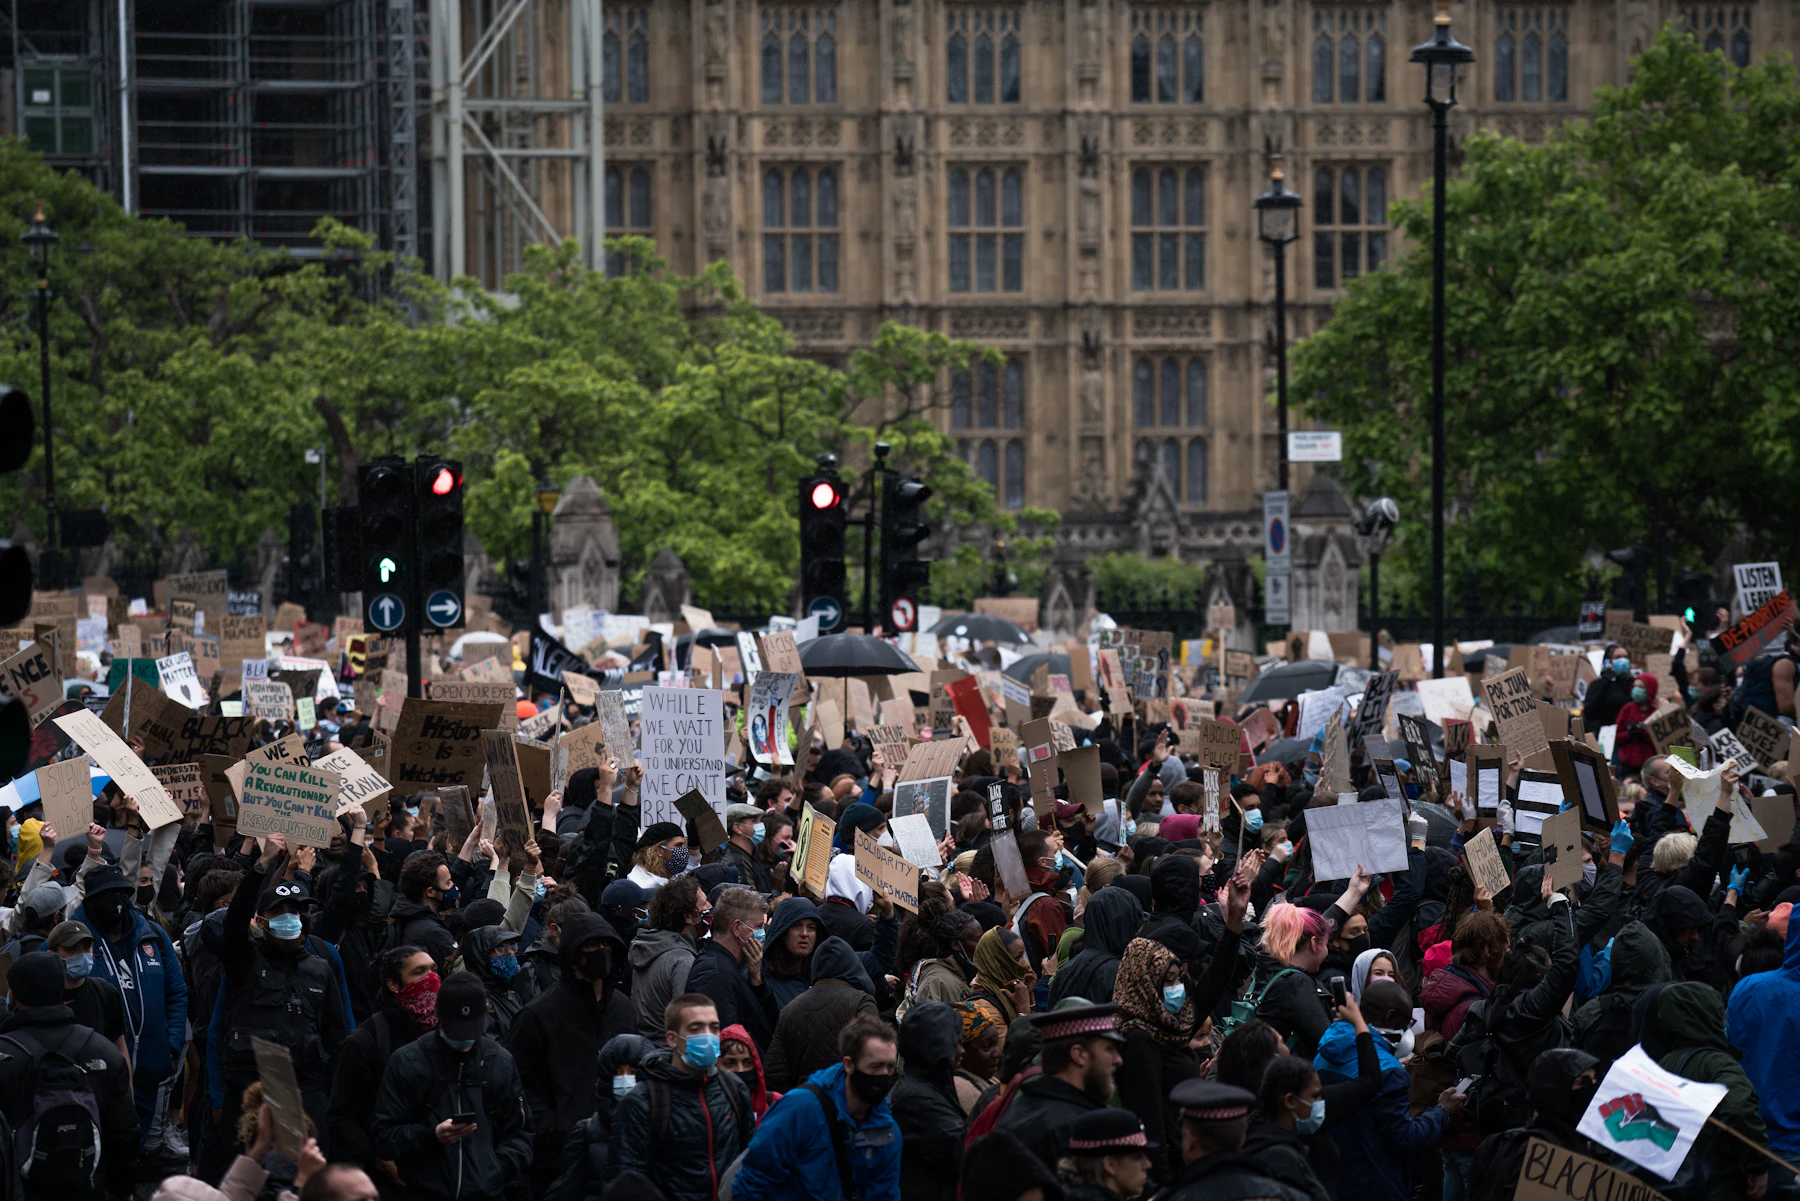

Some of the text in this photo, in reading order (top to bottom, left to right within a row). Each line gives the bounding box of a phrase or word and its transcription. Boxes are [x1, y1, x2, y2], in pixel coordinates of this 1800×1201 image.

[1740, 567, 1777, 588] LISTEN
[224, 627, 261, 640] NAMES
[158, 659, 175, 671] BLACK
[162, 667, 196, 686] MATTER
[433, 685, 516, 699] OPEN YOUR EYES
[1487, 683, 1508, 704] POR
[649, 692, 706, 715] WHILE
[1493, 703, 1513, 724] POR
[181, 717, 252, 740] BLACK
[645, 719, 713, 736] WE WAIT
[1203, 724, 1242, 747] ABOLISH
[264, 742, 290, 761] WE
[654, 739, 703, 754] FOR YOU
[645, 757, 724, 771] TO UNDERSTAND
[47, 759, 91, 798] SILENCE
[645, 774, 672, 796] WE
[1204, 770, 1219, 792] BLACK
[643, 799, 723, 827] BREE
[1205, 791, 1219, 814] LIVES
[242, 811, 329, 841] REVOLUTION
[856, 834, 913, 878] SOLIDARITY
[1478, 856, 1501, 884] MANY
[855, 861, 875, 884] BLACK
[894, 889, 920, 909] MATTER
[1524, 1142, 1608, 1201] BLACK
